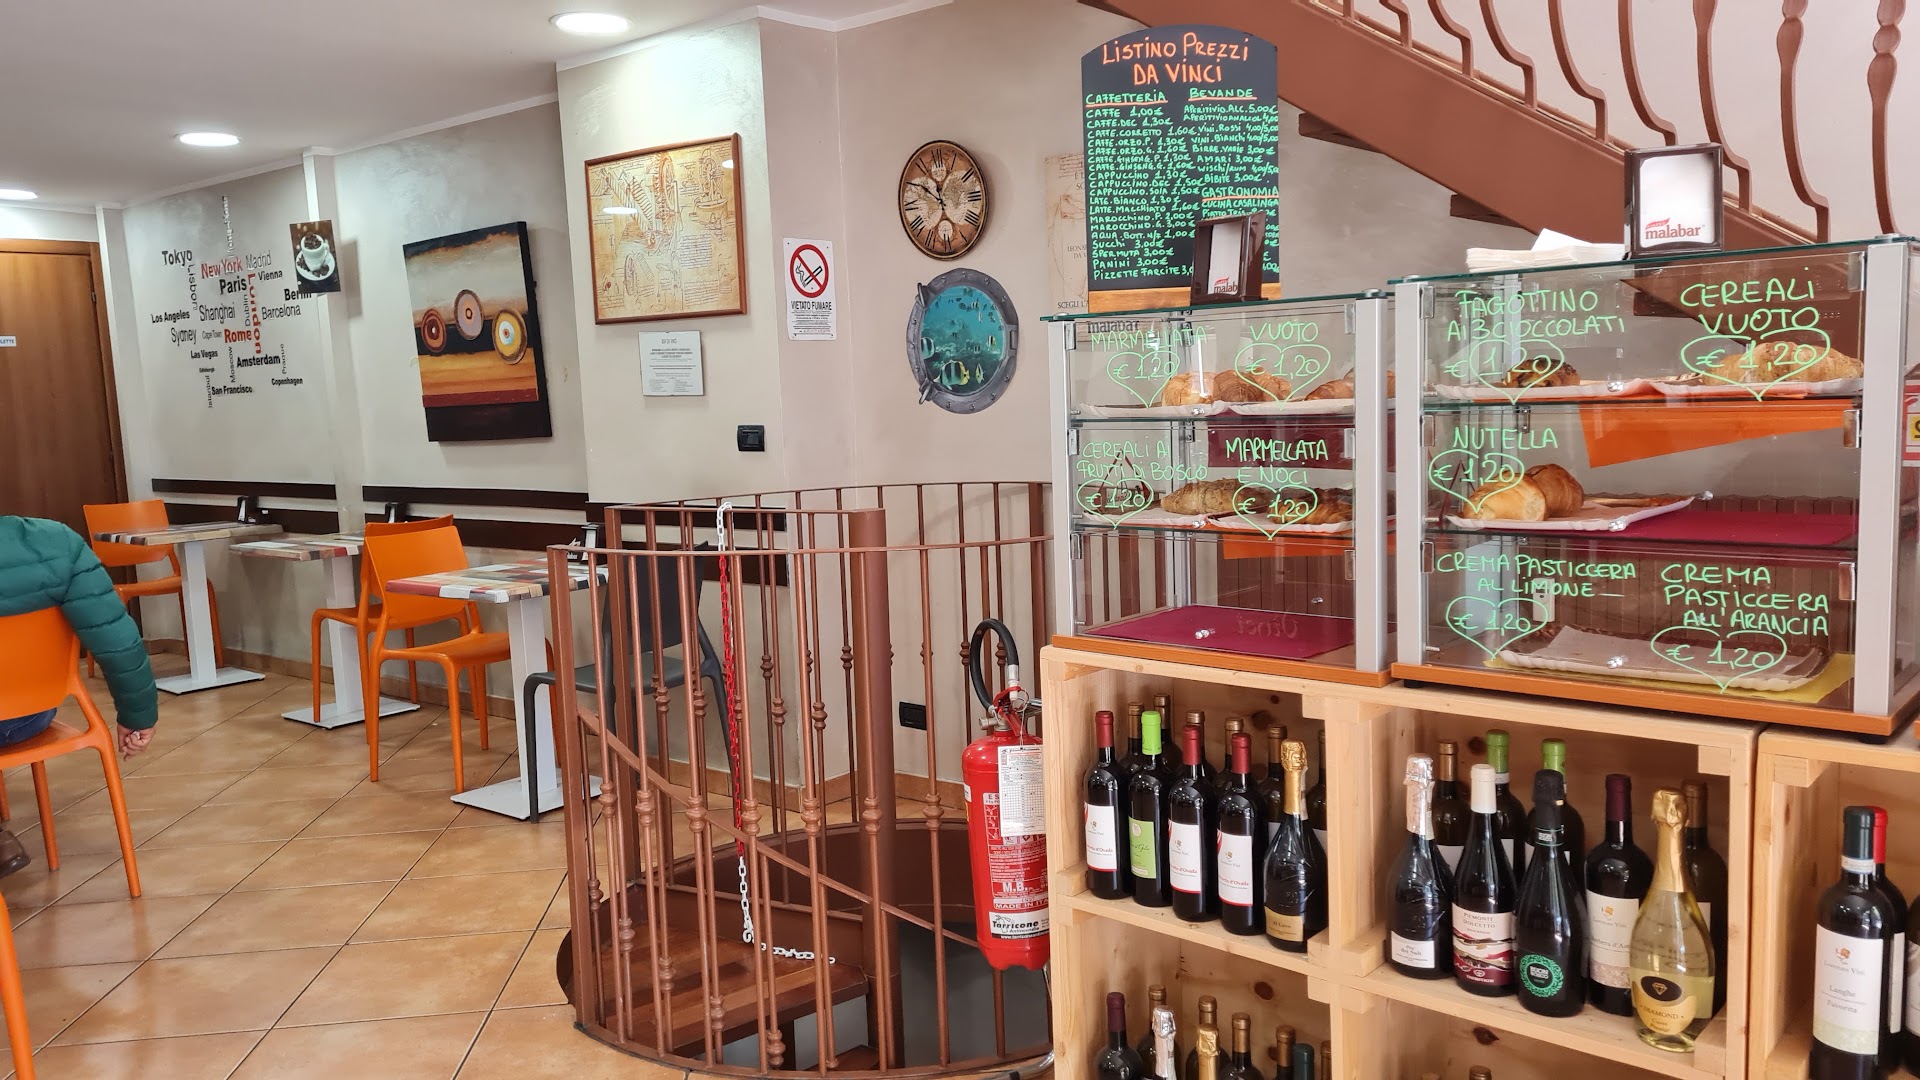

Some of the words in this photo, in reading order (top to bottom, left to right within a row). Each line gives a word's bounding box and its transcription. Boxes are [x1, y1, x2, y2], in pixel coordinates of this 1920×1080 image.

[1134, 63, 1159, 86] DA
[1190, 88, 1253, 98] BEVANDE
[1202, 186, 1278, 198] GASTRONOMIA
[1645, 224, 1701, 240] malabar
[162, 250, 192, 266] Tokyo
[245, 250, 272, 270] Madrid
[201, 262, 221, 280] New
[222, 256, 243, 274] York
[258, 269, 283, 282] Vienna
[187, 264, 198, 310] Lisbon
[219, 276, 247, 294] Paris
[1680, 280, 1815, 307] CEREALI
[198, 302, 236, 324] Shanghai
[261, 304, 301, 320] Barcelona
[791, 301, 810, 310] VIETATO
[812, 302, 832, 310] FUMARE
[1455, 289, 1599, 318] FAGOTTINO
[150, 312, 162, 324] Los
[164, 310, 190, 322] Angeles
[248, 273, 262, 354] London
[1698, 306, 1820, 334] VUOTO
[170, 328, 196, 346] Sydney
[224, 328, 252, 344] Rome
[1091, 326, 1208, 352] MARMELLATA
[1250, 322, 1318, 342] VUOTO
[190, 350, 200, 359] Las
[200, 348, 218, 360] Vegas
[236, 354, 280, 368] Amsterdam
[228, 346, 236, 383] Moscow
[212, 386, 222, 395] San
[223, 384, 252, 394] Francisco
[271, 377, 303, 386] Copenhagen
[1453, 428, 1558, 450] NUTELLA
[1082, 440, 1150, 460] CEREALI
[1225, 436, 1328, 462] MARMELLATA
[1076, 460, 1130, 480] FRUTTI
[1152, 462, 1208, 482] BOSCO
[1237, 467, 1252, 484] E
[1260, 467, 1308, 486] NOCI
[1436, 553, 1510, 574] CREMA
[1661, 562, 1771, 586] CREMA
[1478, 578, 1502, 594] AL
[1511, 576, 1594, 598] LIMONE
[1664, 586, 1830, 614] PASTICCERA
[1002, 882, 1028, 892] M.B.
[992, 920, 1039, 928] Tarricone
[1463, 919, 1496, 928] DOLCETTO
[1464, 912, 1494, 922] PIEMONTE
[1644, 1006, 1678, 1020] DIAMOND
